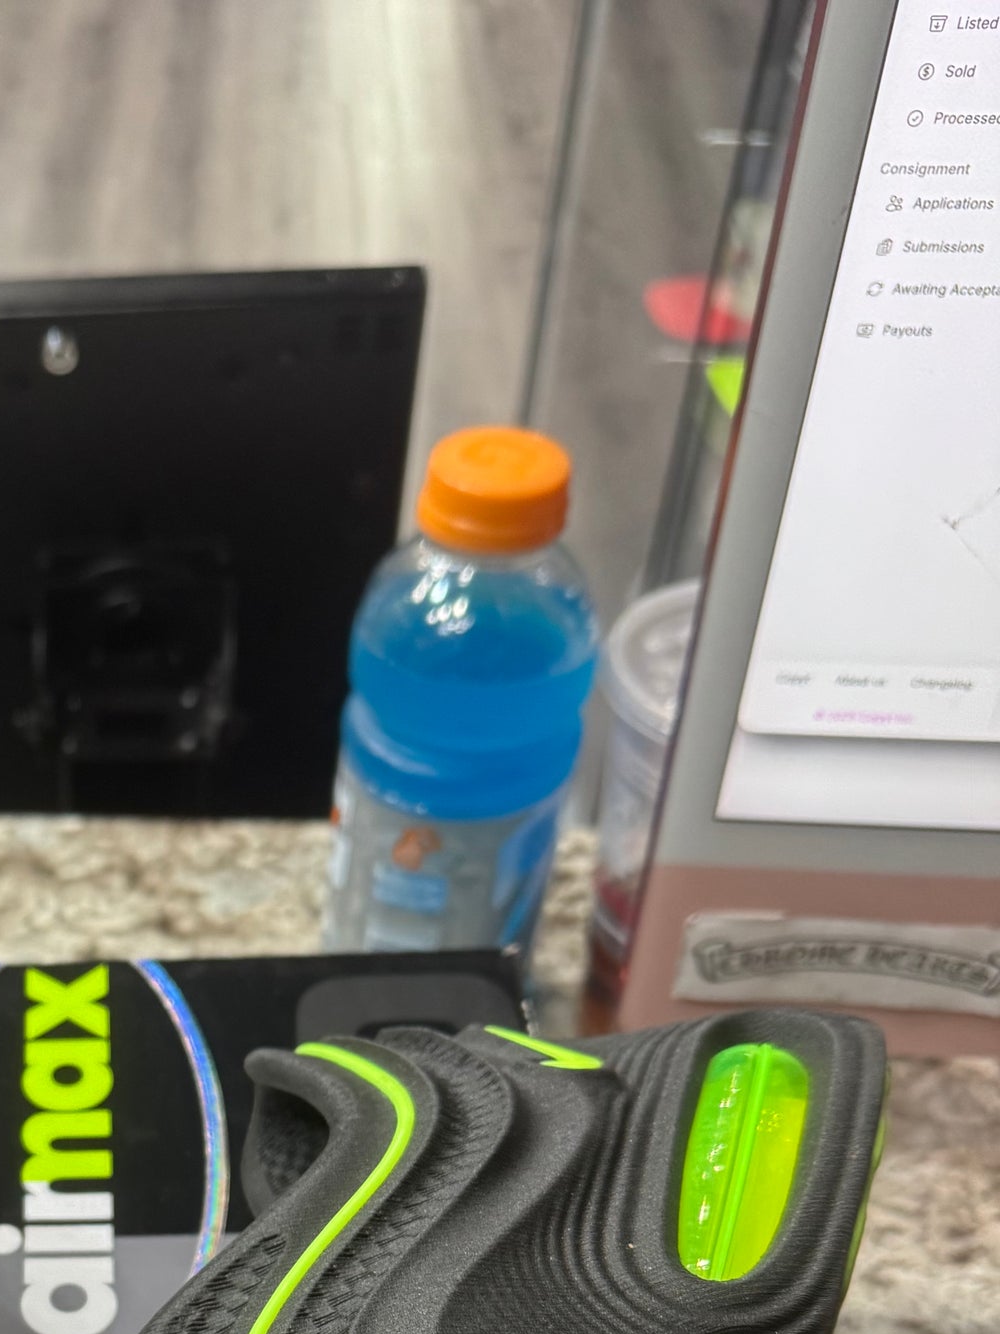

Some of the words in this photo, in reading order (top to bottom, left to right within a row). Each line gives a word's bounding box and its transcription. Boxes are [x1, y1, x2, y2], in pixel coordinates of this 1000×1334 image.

[956, 15, 1000, 30] Listed
[945, 64, 977, 78] Sold
[880, 162, 971, 178] Consignment
[912, 197, 995, 213] Applications
[902, 239, 985, 254] Submissions
[891, 282, 947, 299] Awaiting
[882, 323, 933, 339] Payouts
